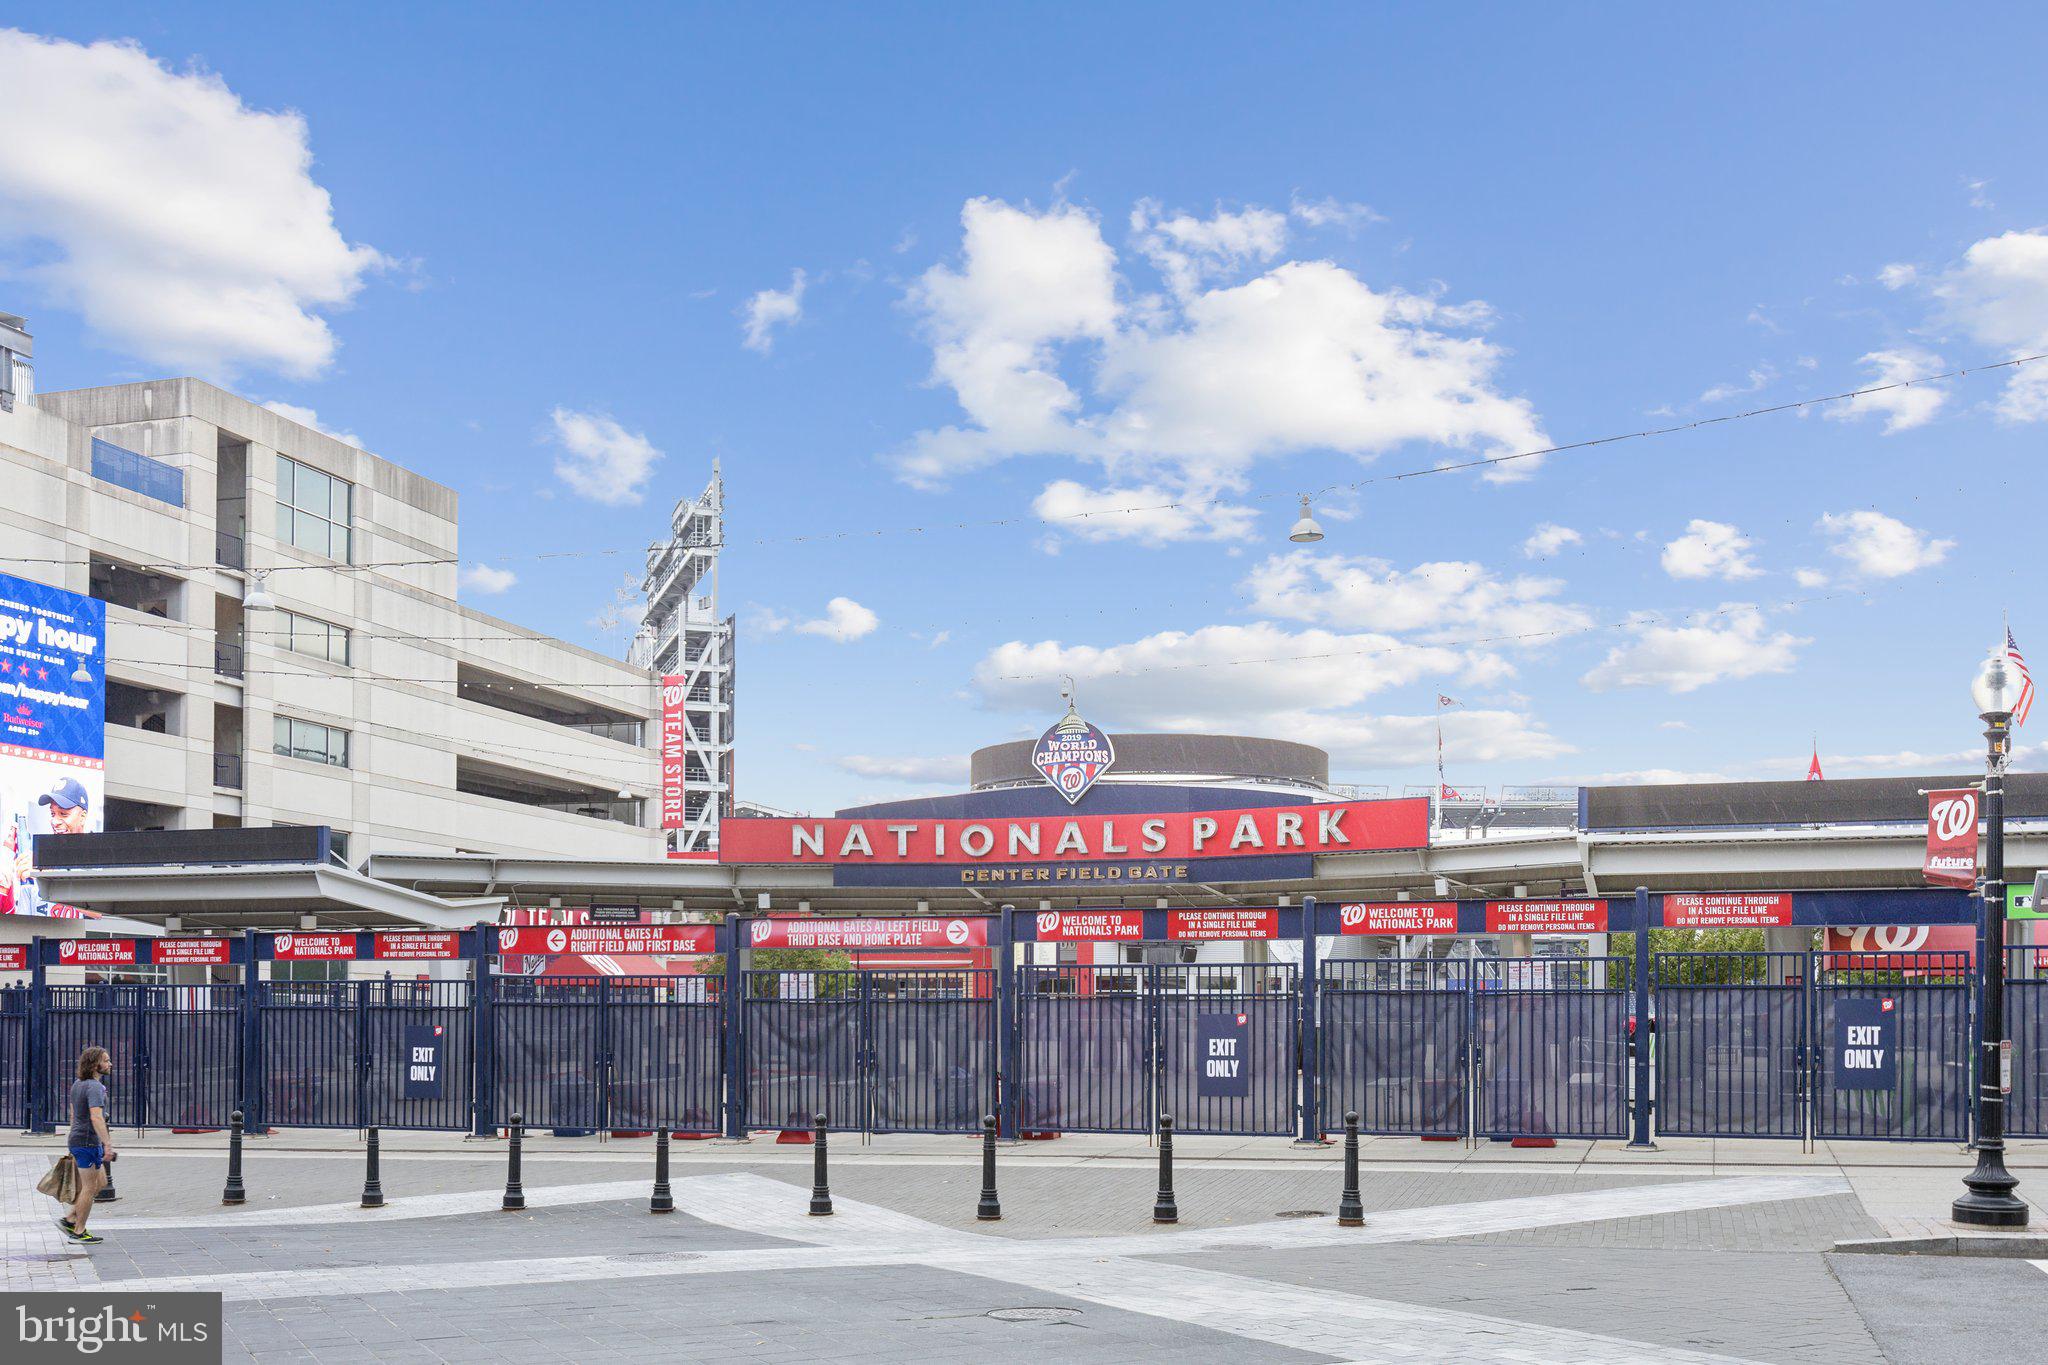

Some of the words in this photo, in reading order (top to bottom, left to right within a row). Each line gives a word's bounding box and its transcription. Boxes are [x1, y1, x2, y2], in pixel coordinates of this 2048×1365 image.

[38, 618, 96, 654] hour
[4, 713, 44, 728] Budweiser
[664, 710, 682, 758] TEAM
[1048, 740, 1098, 751] WORLD
[1036, 750, 1108, 766] CHAMPIONS
[664, 764, 682, 822] STORE
[792, 819, 1168, 857] NATIONALS
[1192, 808, 1350, 851] PARK
[1930, 856, 1974, 869] future
[961, 868, 1050, 882] CENTER
[1056, 866, 1122, 880] FIELD
[1128, 865, 1188, 880] GATE
[1370, 908, 1418, 919] WELCOME
[1422, 908, 1434, 919] TO
[1498, 904, 1523, 912] PLEASE
[1526, 904, 1560, 912] CONTINUE
[1562, 904, 1594, 912] THROUGH
[528, 908, 574, 926] TEM
[1062, 916, 1108, 926] WELCOME
[1110, 916, 1122, 926] TO
[1179, 912, 1201, 920] PLEASE
[1204, 912, 1234, 920] CONTINUE
[1236, 912, 1266, 920] THROUGH
[788, 921, 840, 933] ADDITIONAL
[843, 921, 872, 933] GATES
[874, 921, 886, 933] AT
[888, 921, 910, 933] LEFT
[912, 921, 942, 933] FIELD,
[1188, 921, 1195, 929] IN
[1196, 921, 1202, 929] A
[1202, 921, 1224, 929] SINGLE
[1226, 921, 1240, 929] FILE
[1242, 921, 1256, 929] LINE
[1370, 918, 1424, 929] NATIONALS
[1427, 918, 1453, 928] PARK
[570, 928, 622, 940] ADDITIONAL
[624, 928, 650, 940] GATES
[652, 928, 664, 940] AT
[1062, 926, 1112, 936] NATIONALS
[1114, 925, 1139, 936] PARK
[294, 938, 330, 946] WELCOME
[331, 938, 340, 946] TO
[570, 940, 597, 952] RIGHT
[599, 940, 624, 952] FIELD
[626, 940, 644, 952] AND
[648, 940, 672, 952] FIRST
[674, 940, 696, 952] BASE
[788, 934, 814, 946] THIRD
[818, 934, 840, 946] BASE
[843, 934, 862, 946] AND
[865, 934, 892, 946] HOME
[894, 934, 922, 946] PLATE
[78, 944, 110, 952] WELCOME
[112, 944, 120, 952] TO
[294, 946, 332, 955] NATIONALS
[334, 946, 354, 954] PARK
[78, 952, 113, 960] NATIONALS
[115, 952, 132, 960] PARK
[1848, 1026, 1882, 1046] EXIT
[1209, 1038, 1236, 1056] EXIT
[412, 1047, 434, 1062] EXIT
[1844, 1049, 1884, 1069] ONLY
[410, 1066, 436, 1082] ONLY
[1206, 1060, 1240, 1078] ONLY
